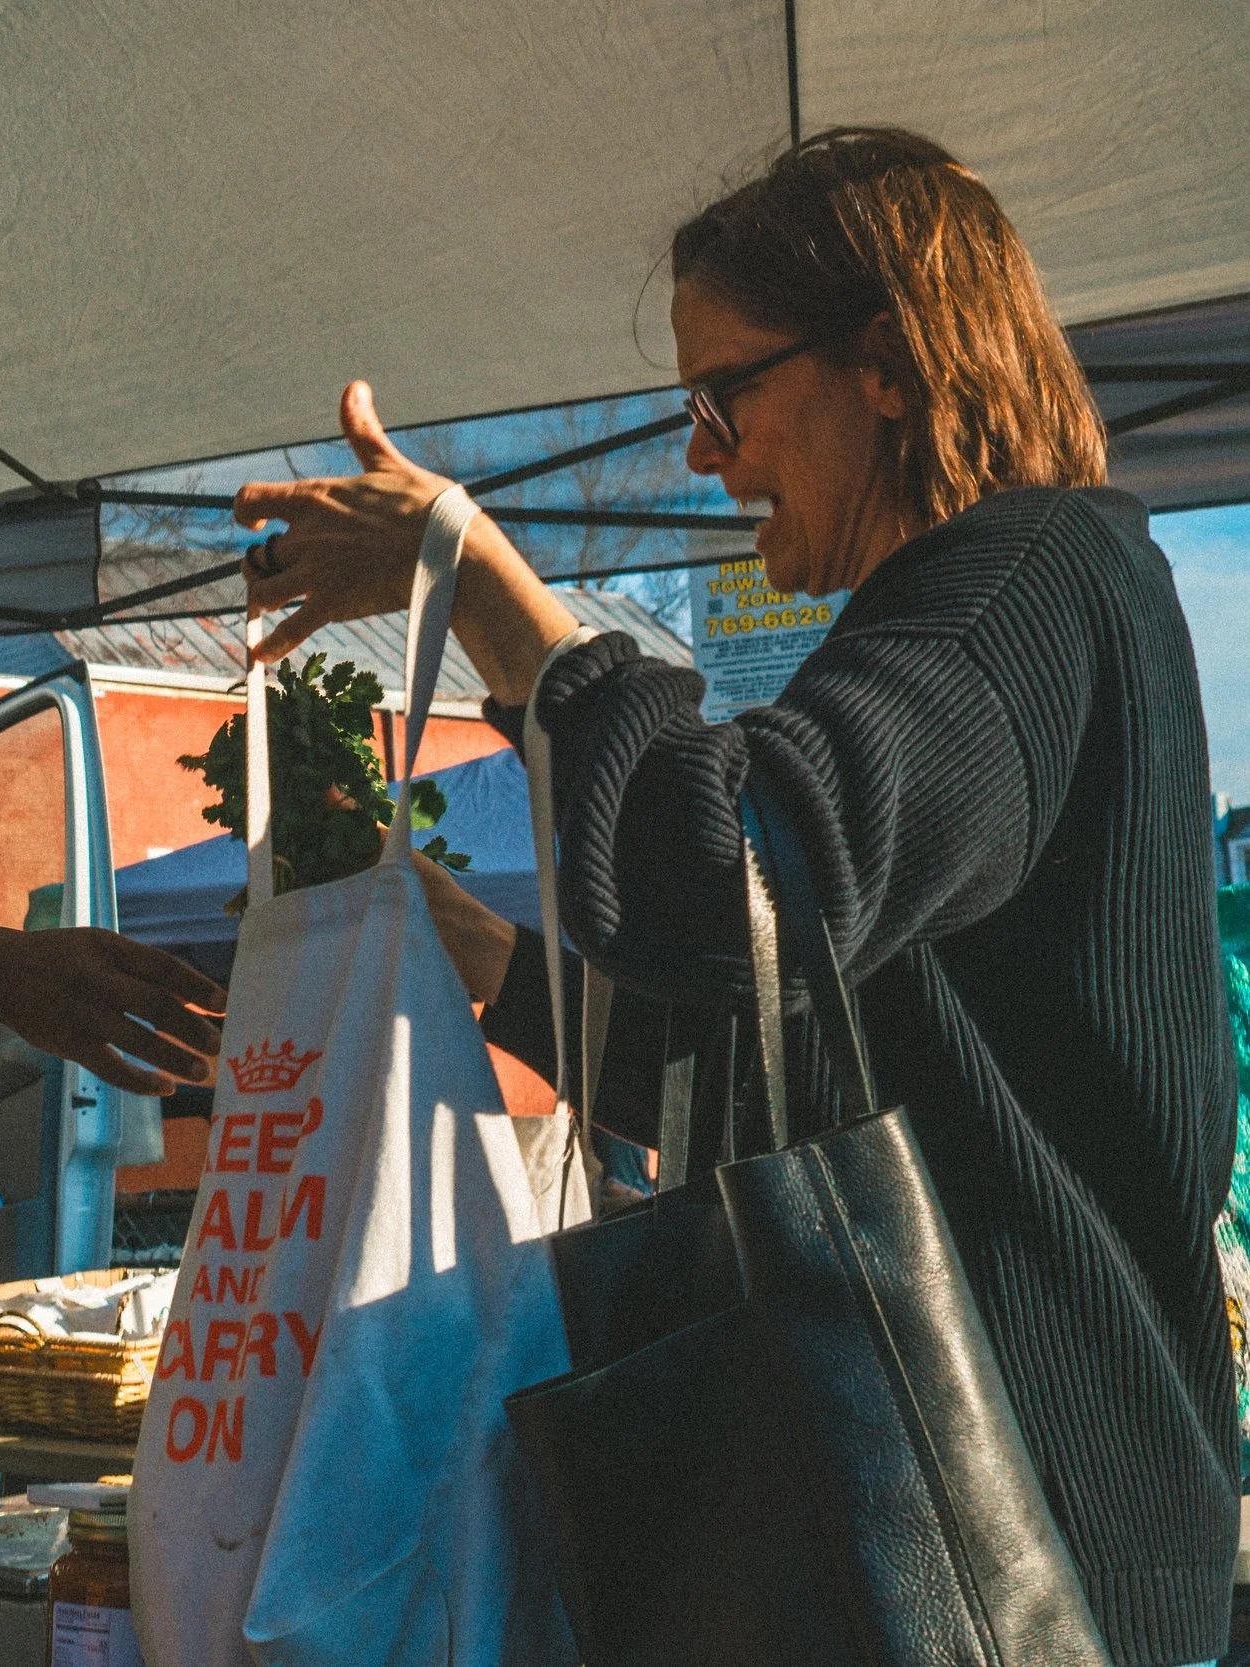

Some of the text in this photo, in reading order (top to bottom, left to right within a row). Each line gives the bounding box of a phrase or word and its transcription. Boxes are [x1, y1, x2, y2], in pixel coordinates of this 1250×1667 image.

[708, 576, 768, 596] TOW-
[720, 559, 765, 576] PRIV
[706, 604, 831, 637] 769-6626
[206, 1096, 324, 1173] EEP
[197, 1174, 327, 1252] ALM
[166, 1395, 245, 1464] ON
